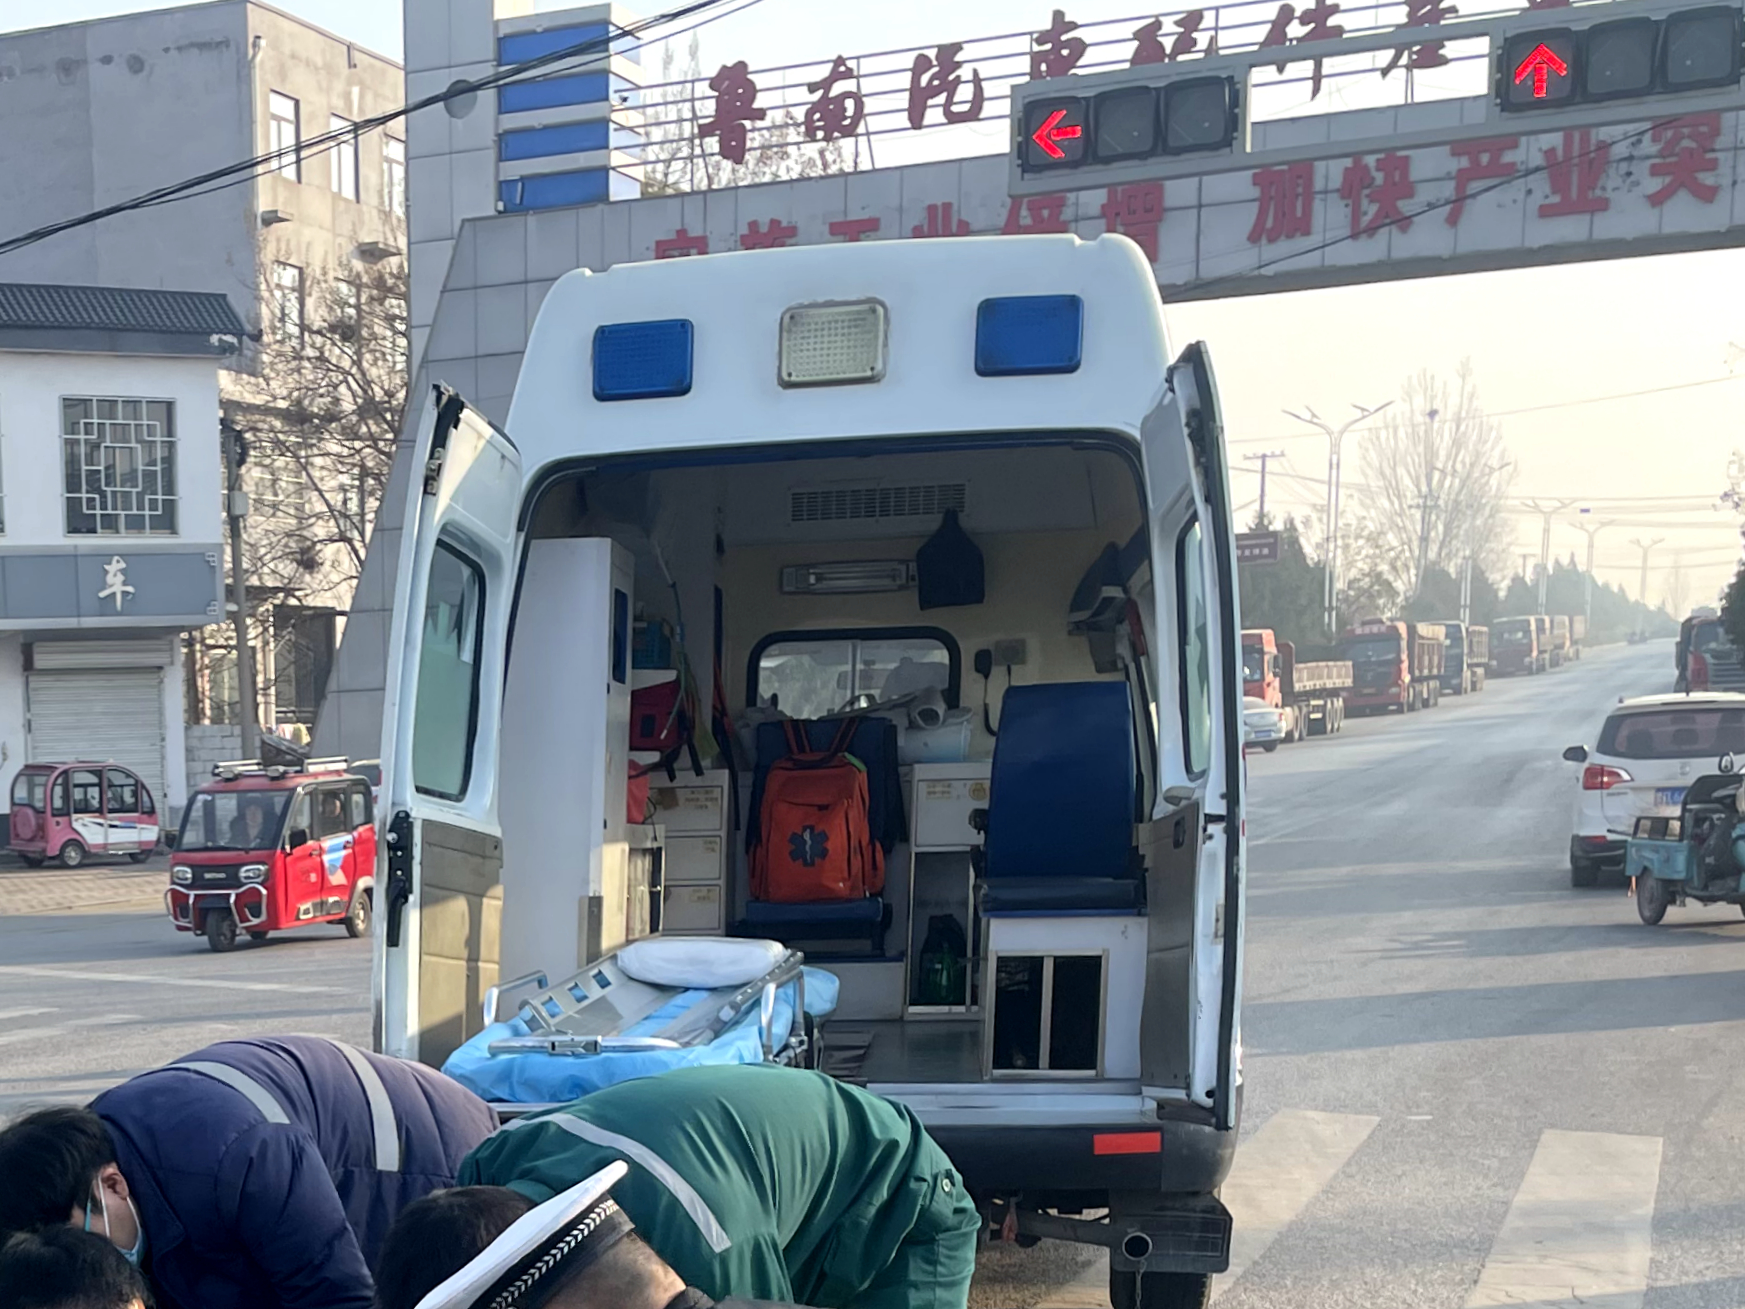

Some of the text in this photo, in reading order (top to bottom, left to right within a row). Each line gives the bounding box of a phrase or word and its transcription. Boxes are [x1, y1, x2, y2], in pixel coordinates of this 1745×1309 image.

[1247, 111, 1723, 243] 加快产业突
